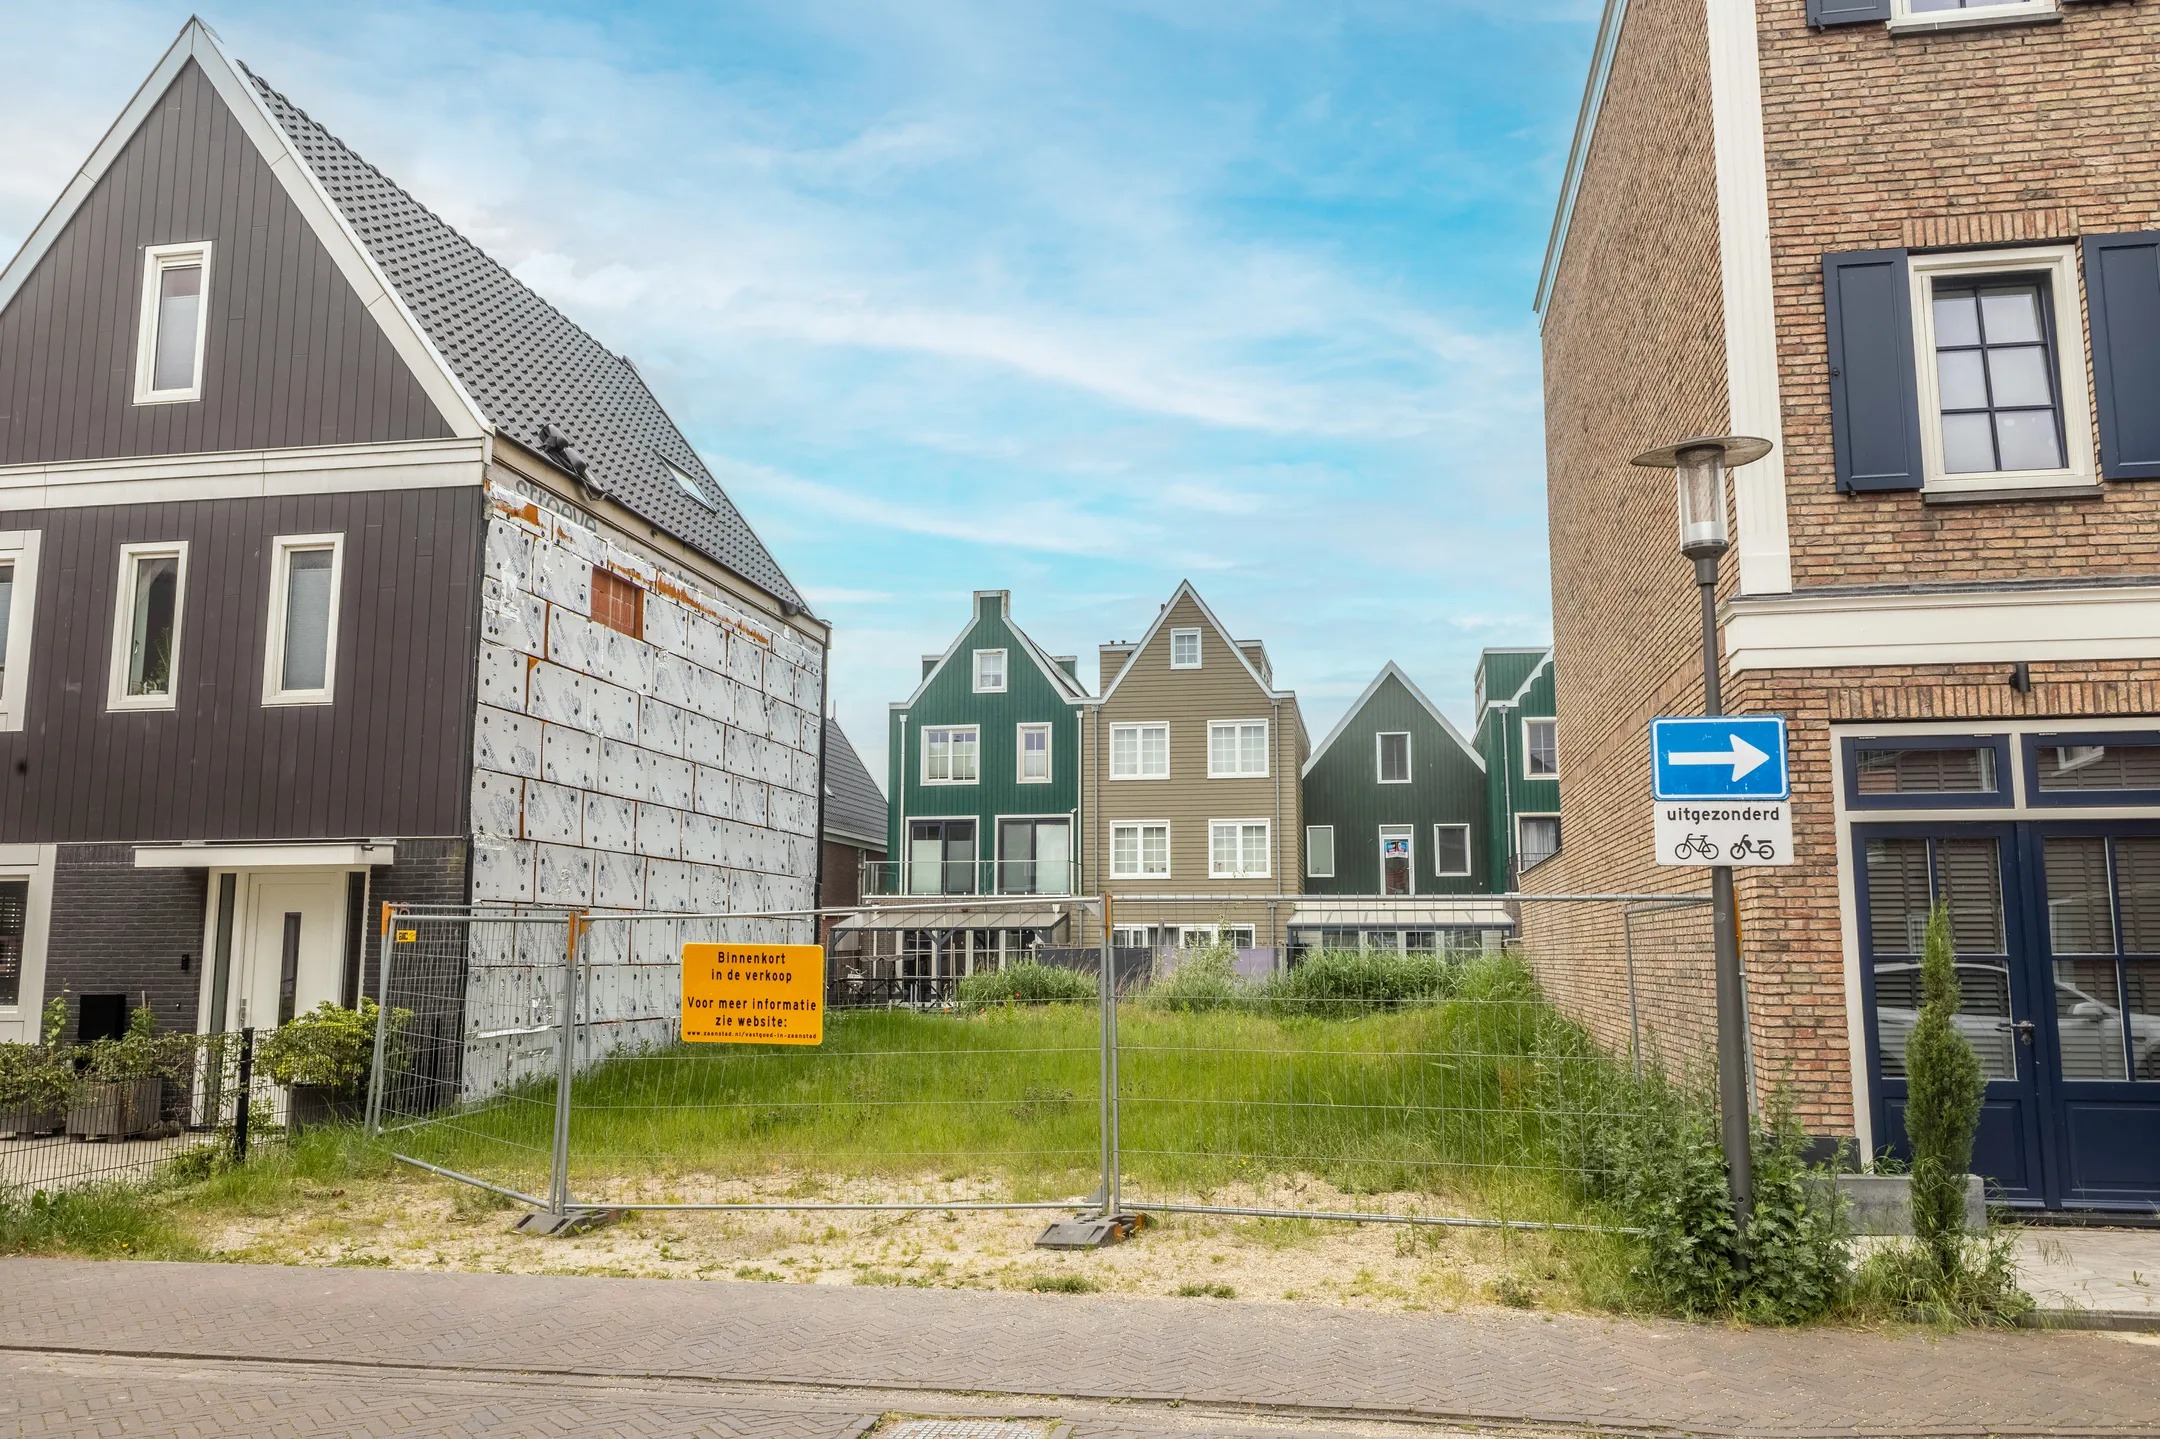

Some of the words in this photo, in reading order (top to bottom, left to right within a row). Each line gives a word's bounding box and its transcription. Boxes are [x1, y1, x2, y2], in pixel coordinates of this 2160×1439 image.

[1667, 807, 1780, 825] uitgezonderd
[718, 951, 786, 964] Binnenkort
[711, 968, 722, 980] in
[727, 969, 740, 981] de
[745, 970, 792, 984] verkoop
[687, 996, 714, 1009] Voor
[718, 999, 748, 1009] meer
[752, 998, 817, 1011] informatie
[715, 1014, 733, 1026] zie
[738, 1015, 788, 1028] website:
